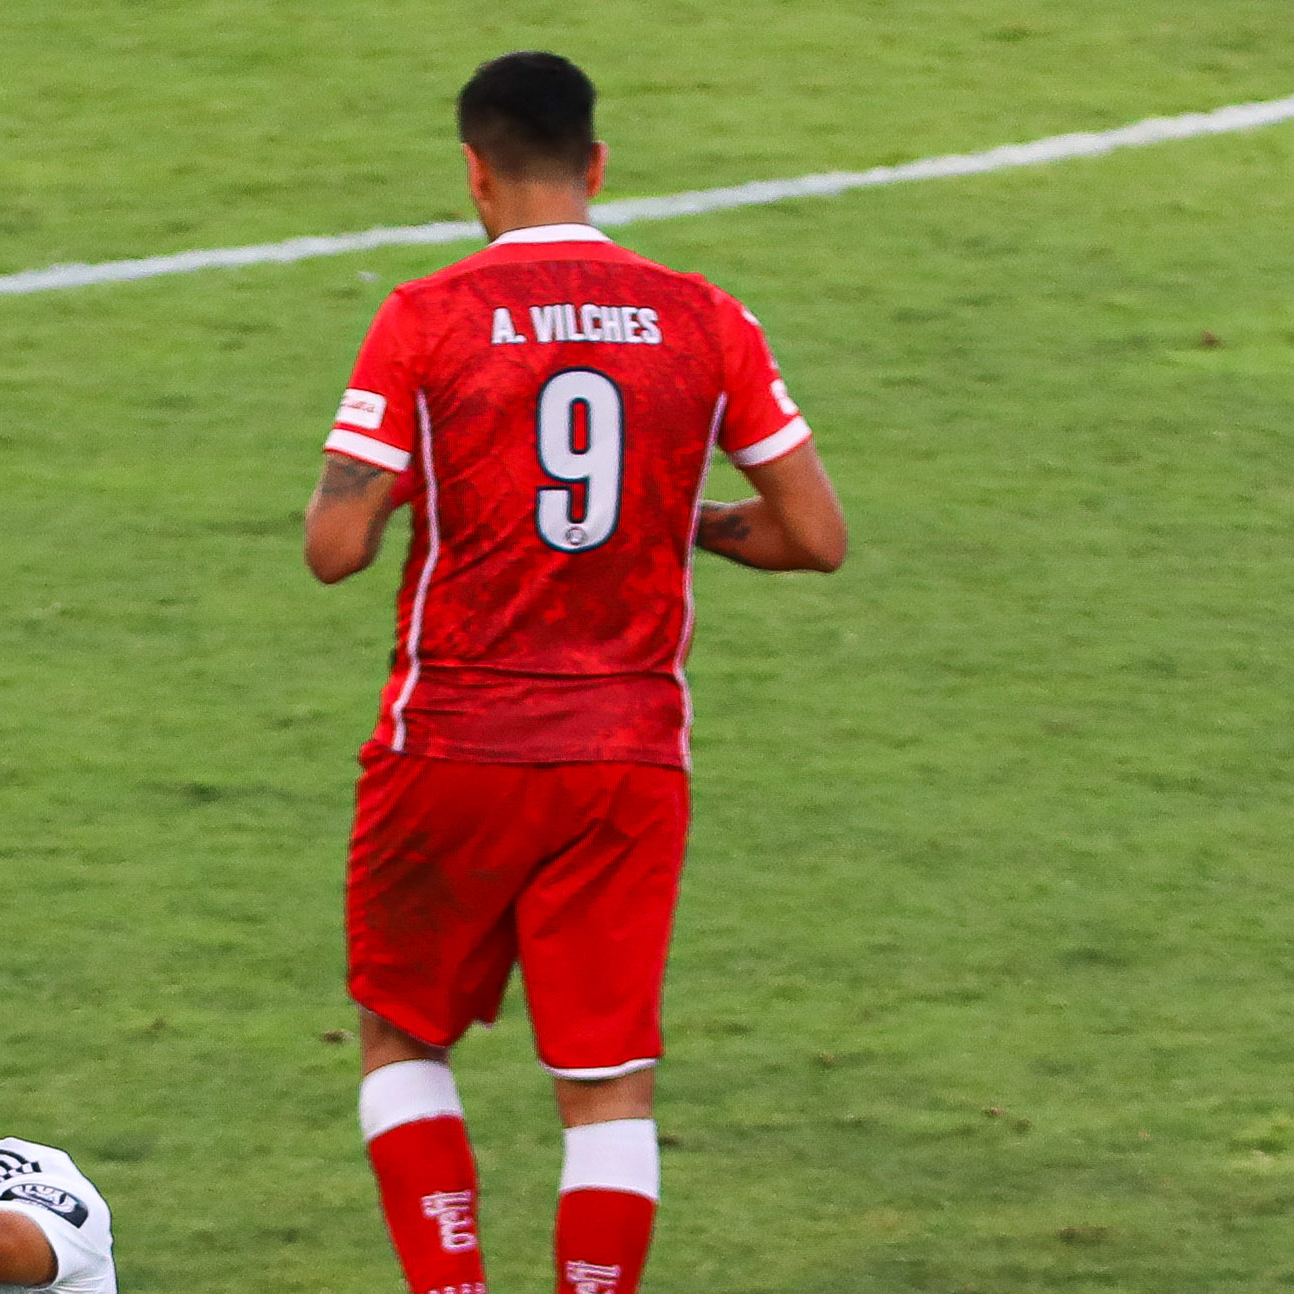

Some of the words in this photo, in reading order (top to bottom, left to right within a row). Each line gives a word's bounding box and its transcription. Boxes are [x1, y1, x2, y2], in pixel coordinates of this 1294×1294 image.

[491, 305, 528, 345] A.
[528, 302, 663, 344] VILCHES
[536, 366, 623, 553] 9
